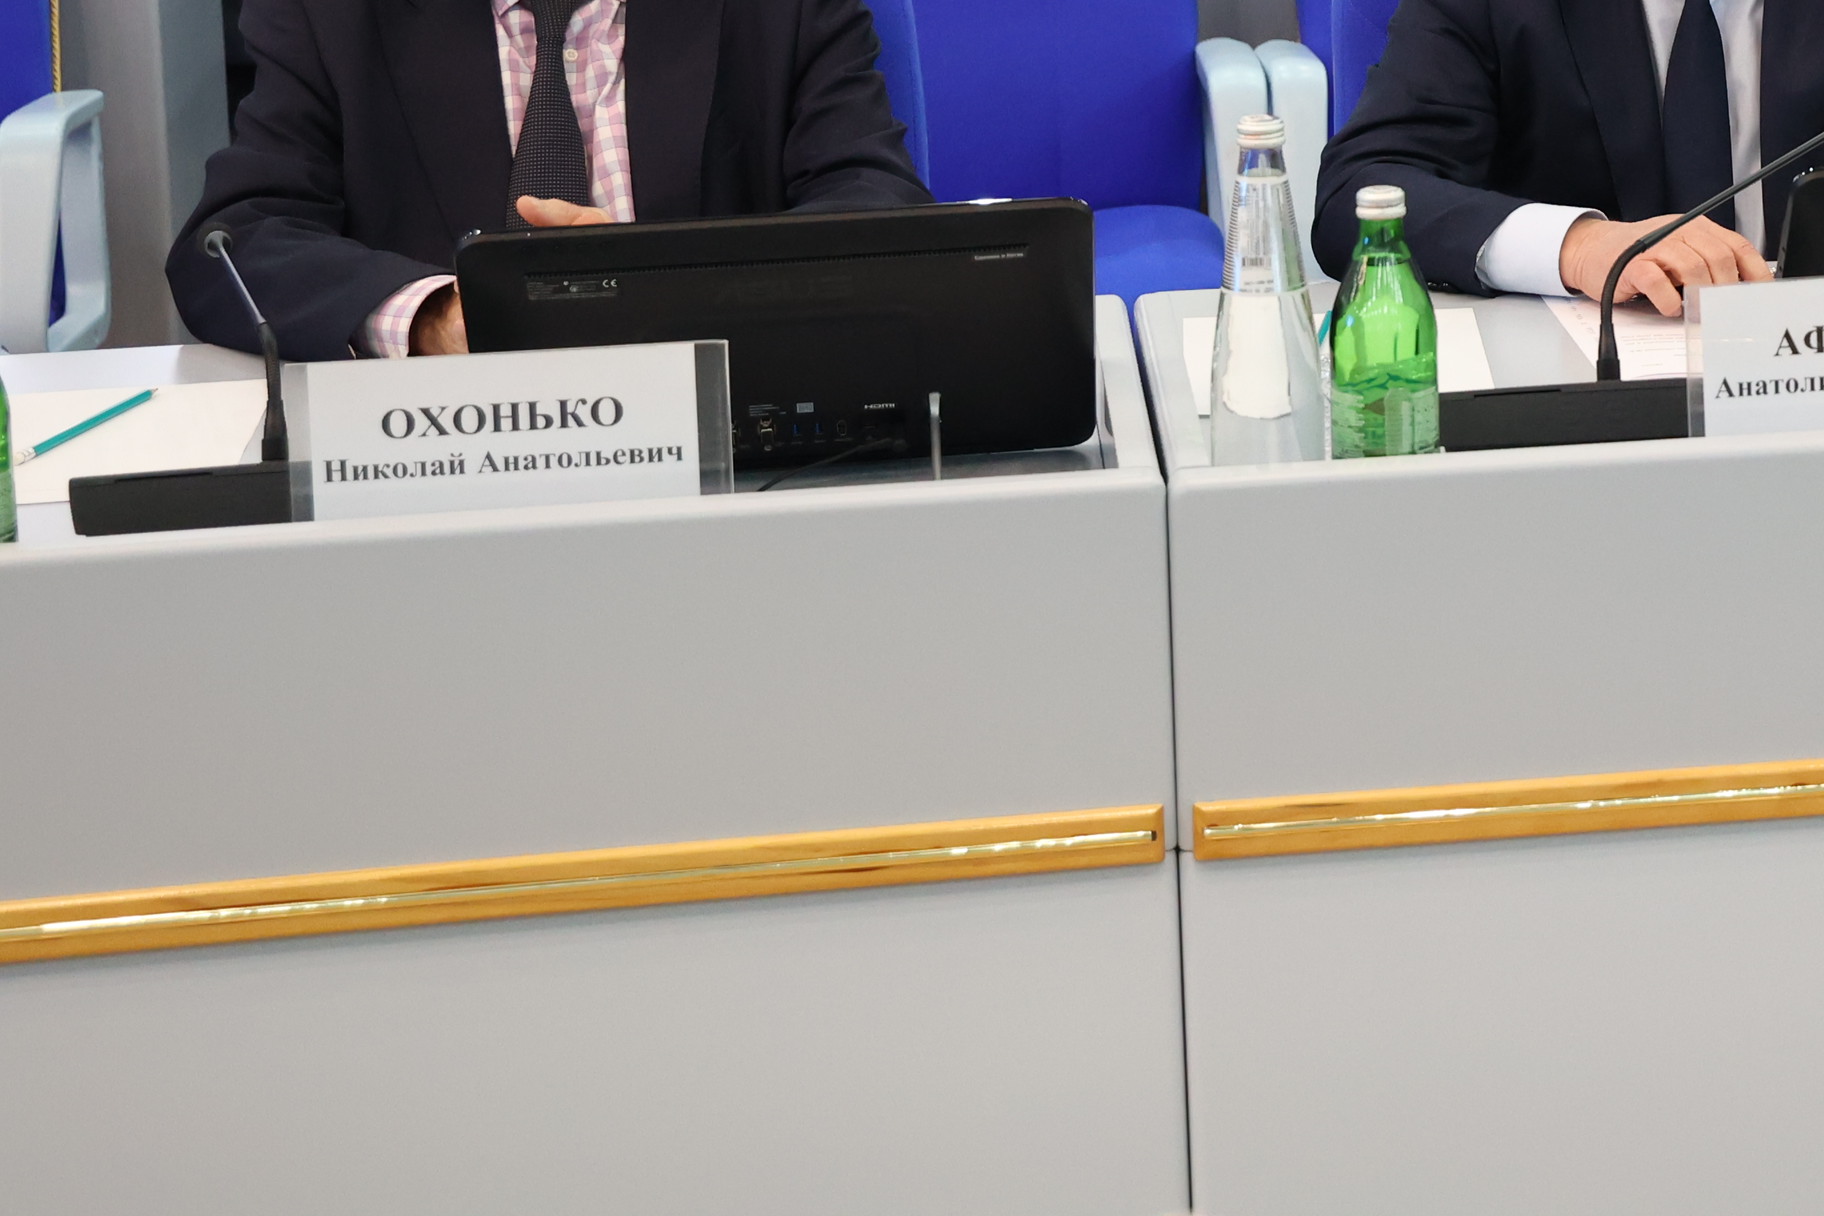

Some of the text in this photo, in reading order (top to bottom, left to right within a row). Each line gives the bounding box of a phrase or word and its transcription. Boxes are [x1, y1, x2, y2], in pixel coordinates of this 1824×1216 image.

[380, 395, 625, 440] ОХОНЬКО
[323, 445, 685, 484] Николай Анатольевич
